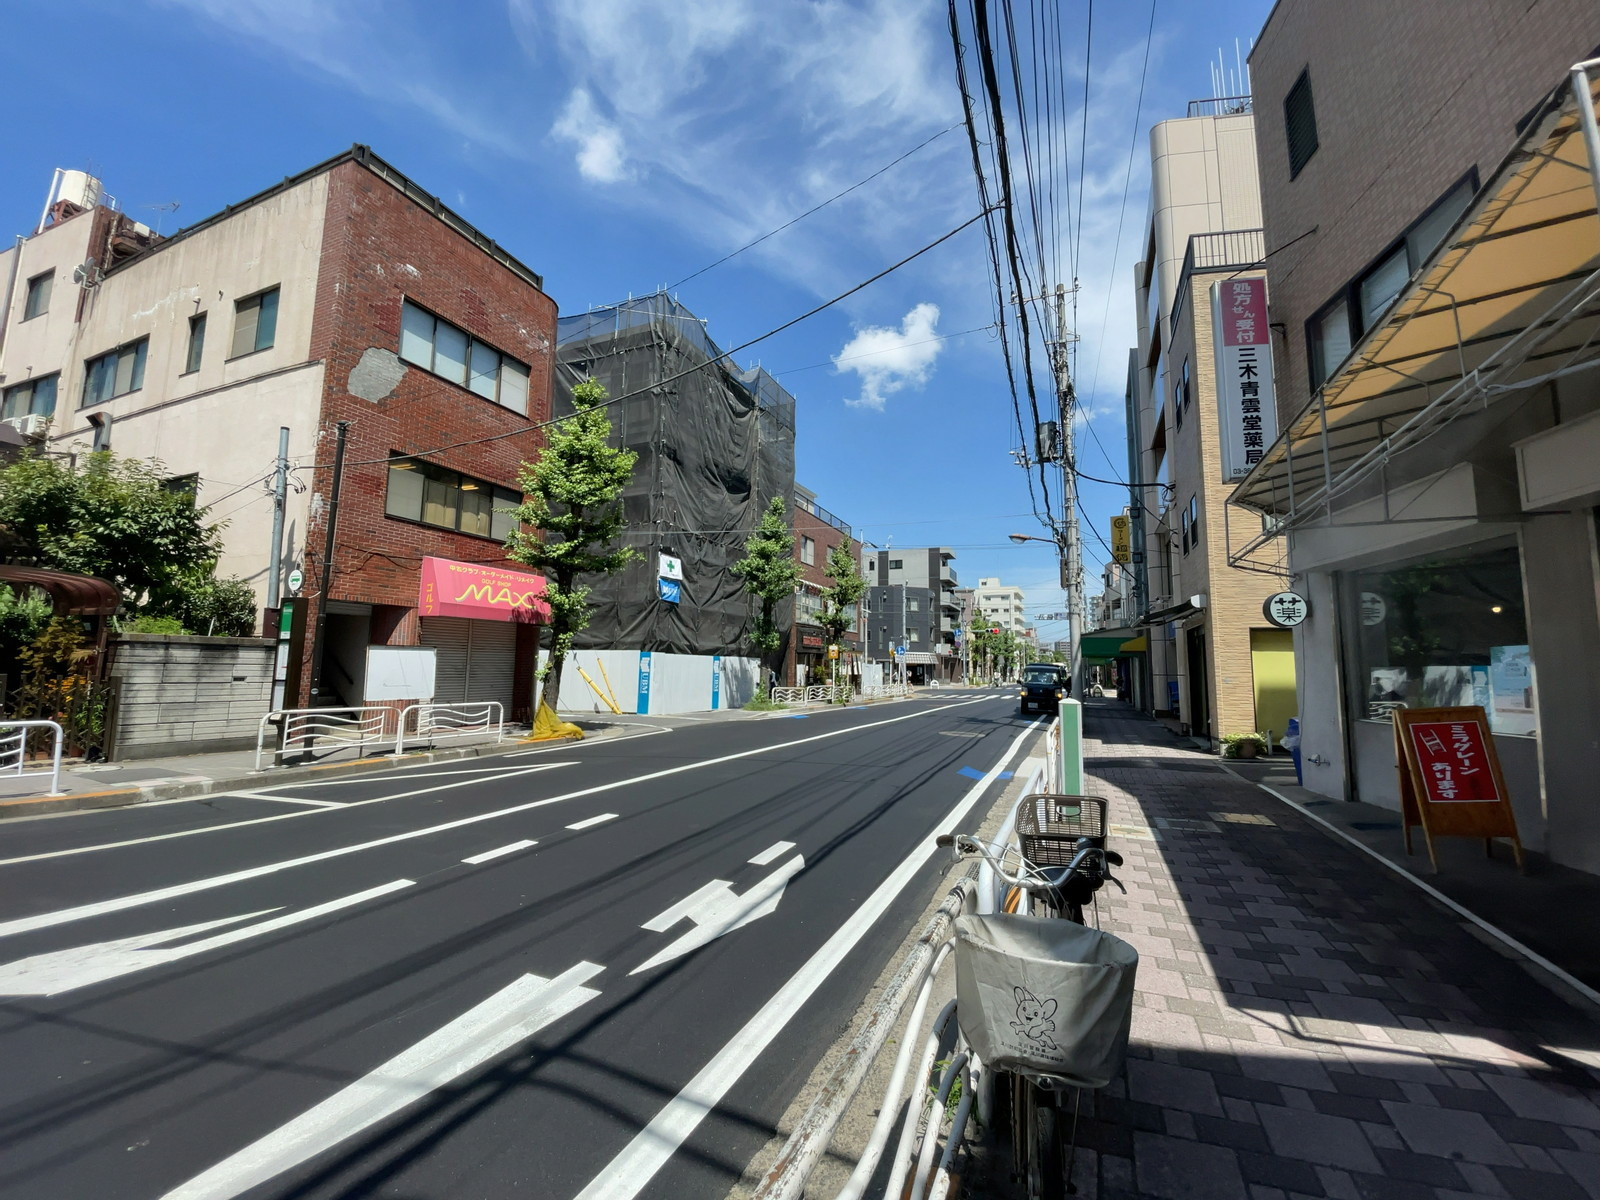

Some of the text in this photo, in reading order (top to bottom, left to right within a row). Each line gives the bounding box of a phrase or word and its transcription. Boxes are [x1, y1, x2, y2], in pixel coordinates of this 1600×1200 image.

[1232, 282, 1256, 343] 処方せん受付
[1238, 347, 1264, 465] 三木青雲堂薬局
[425, 583, 434, 615] ゴルフ
[455, 584, 536, 609] MAX
[481, 578, 512, 588] GOLF SHOP
[1274, 597, 1302, 623] 薬
[641, 673, 649, 694] UBM
[1451, 725, 1480, 775] ミラグレーン
[1431, 762, 1459, 799] あります
